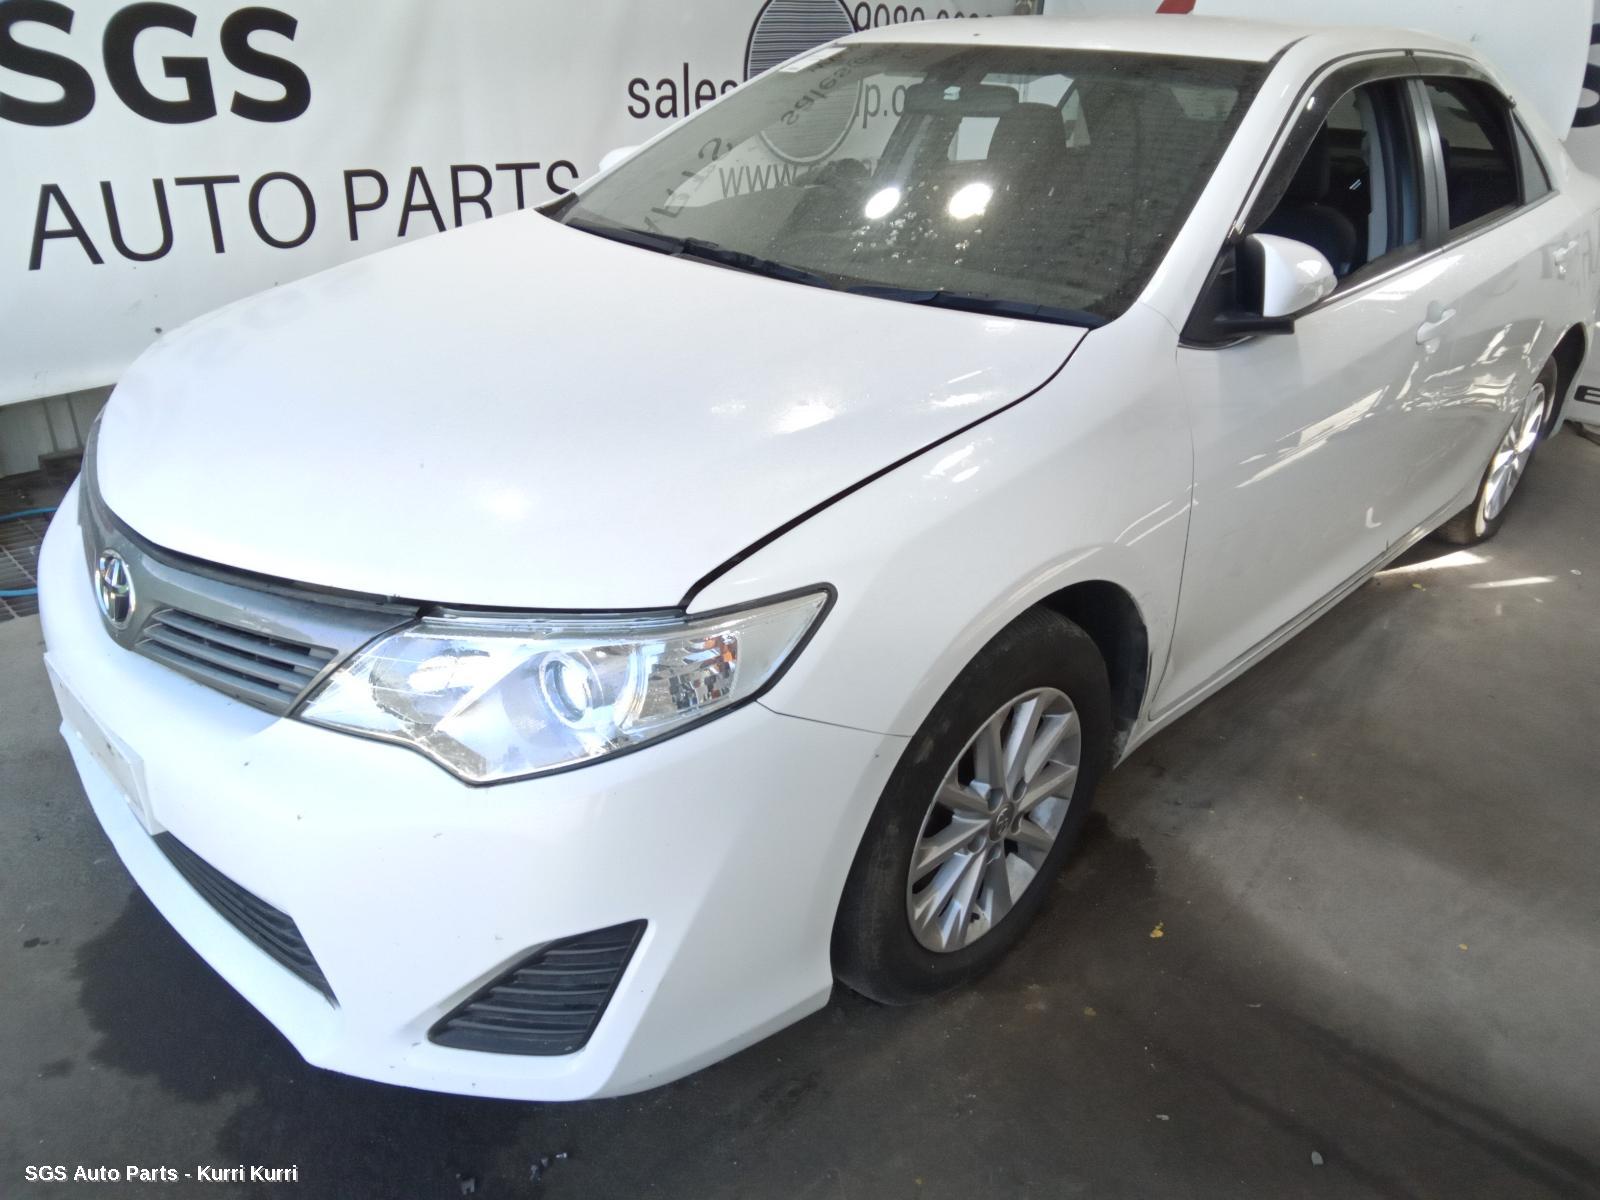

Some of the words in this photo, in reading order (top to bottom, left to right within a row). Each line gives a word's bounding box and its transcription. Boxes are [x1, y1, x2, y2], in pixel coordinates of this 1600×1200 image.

[0, 0, 311, 127] SGS
[28, 171, 317, 271] AUTO
[343, 160, 579, 241] PARTS
